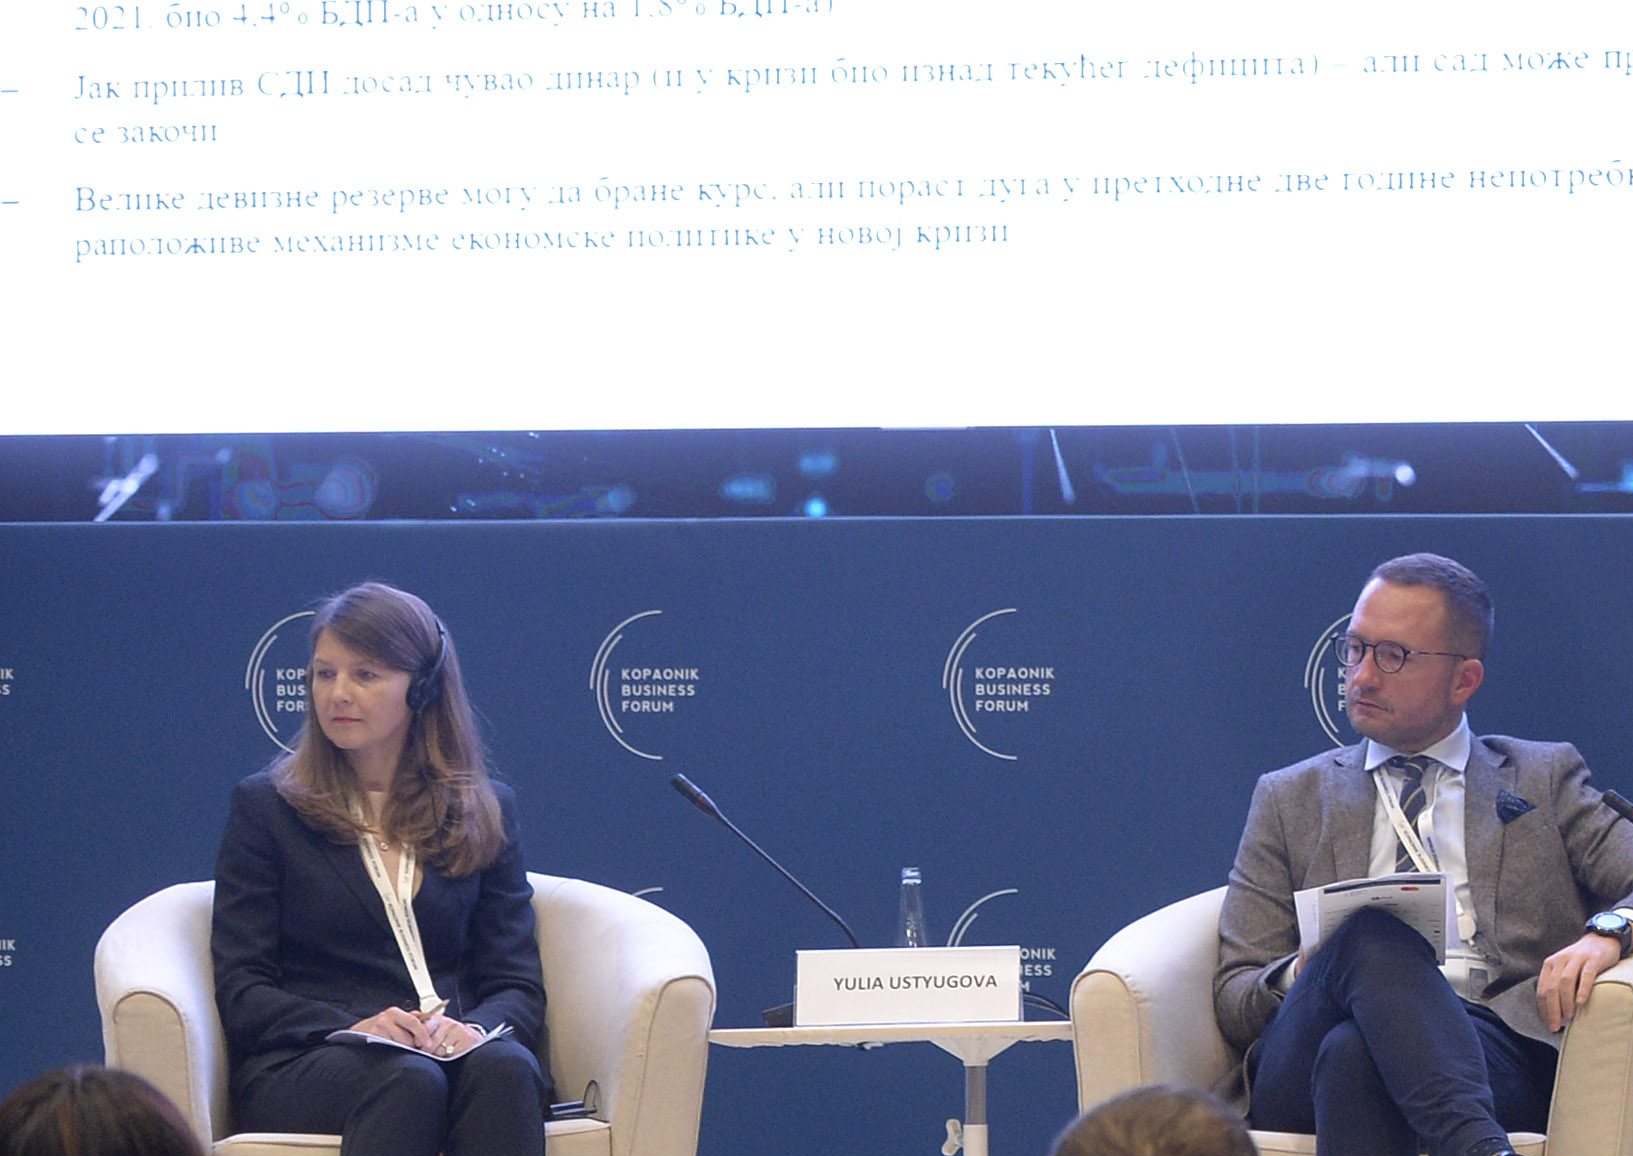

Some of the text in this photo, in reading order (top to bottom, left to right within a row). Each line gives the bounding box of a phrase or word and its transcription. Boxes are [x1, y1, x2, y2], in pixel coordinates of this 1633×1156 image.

[321, 0, 417, 28] БДП-а
[432, 5, 447, 30] у
[460, 2, 569, 26] односу
[583, 2, 616, 18] на
[74, 75, 120, 99] Јак
[134, 80, 243, 105] прилив
[343, 76, 432, 95] досад
[445, 71, 534, 99] чувао
[546, 71, 639, 96] динар
[696, 69, 712, 94] у
[728, 67, 816, 93] кризи
[832, 58, 887, 83] био
[903, 64, 992, 82] изнад
[1008, 53, 1128, 86] текућег
[1364, 55, 1419, 73] али
[1434, 54, 1488, 72] сад
[1503, 52, 1589, 70] може
[74, 125, 216, 144] се закочи
[76, 187, 184, 211] Велике
[197, 191, 318, 210] девизне
[332, 189, 448, 214] резерве
[463, 187, 536, 211] могу
[548, 187, 581, 204] да
[595, 177, 684, 210] бране
[791, 182, 844, 199] али
[859, 180, 963, 205] пораст
[979, 179, 1049, 203] дуга
[1063, 178, 1079, 202] у
[1094, 176, 1261, 202] претходне
[1275, 174, 1328, 192] две
[1344, 172, 1455, 191] године
[274, 234, 439, 253] механизме
[452, 232, 615, 250] економске
[629, 229, 775, 247] политике
[788, 228, 804, 252] у
[818, 227, 901, 251] новој
[917, 225, 1008, 250] кризи
[622, 669, 699, 680] KOPAONIK
[976, 668, 1054, 679] KOPAONIK
[622, 685, 694, 696] BUSINESS
[976, 684, 1050, 695] BUSINESS
[277, 701, 305, 712] FOR
[622, 701, 673, 712] FORUM
[976, 700, 1028, 711] FORUM
[1020, 948, 1056, 960] ONIK
[833, 974, 998, 990] YULIA USTYUGOVA
